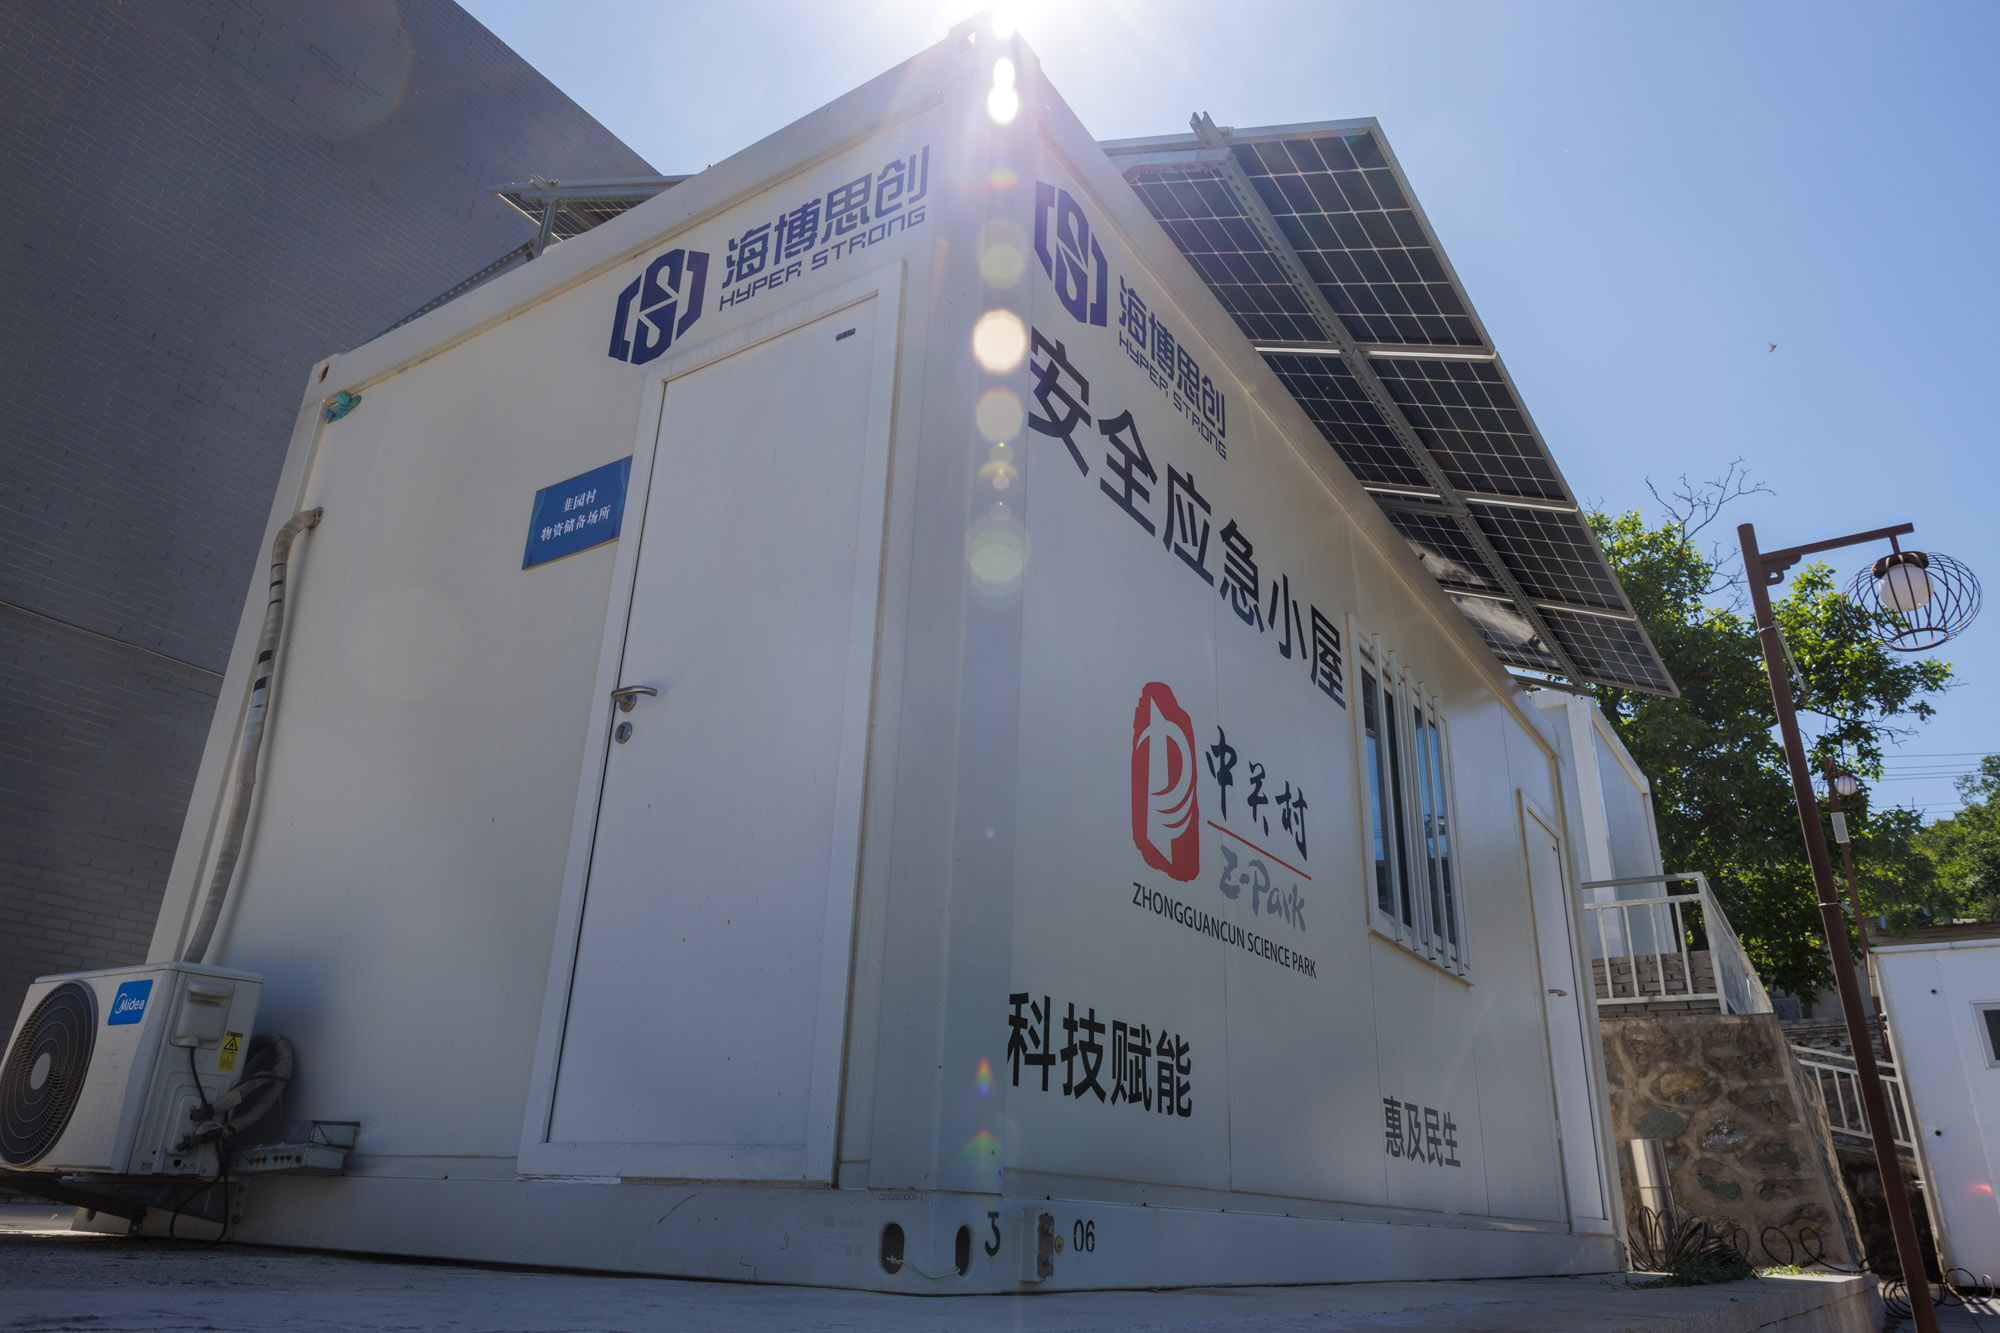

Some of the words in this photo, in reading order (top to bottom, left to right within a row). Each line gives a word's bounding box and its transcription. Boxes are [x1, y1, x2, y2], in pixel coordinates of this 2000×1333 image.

[719, 267, 803, 311] HYPER
[811, 205, 926, 271] STRONG
[721, 144, 930, 289] 海博思创
[1118, 274, 1226, 439] 海博思创
[1118, 330, 1169, 398] HYPER
[1173, 391, 1227, 460] STRONG
[540, 504, 612, 542] 物资储备场所
[1028, 325, 1346, 710] 安全应急小屋
[1205, 725, 1308, 862] 中关村
[1132, 881, 1245, 949] ZHONGGUANCUN
[1247, 932, 1290, 968] SCIENCE
[1292, 951, 1317, 979] PARK
[114, 992, 145, 1014] Midea
[1006, 992, 1193, 1118] 科技赋能
[1382, 1095, 1461, 1168] 惠及民生
[1074, 1219, 1095, 1253] 06
